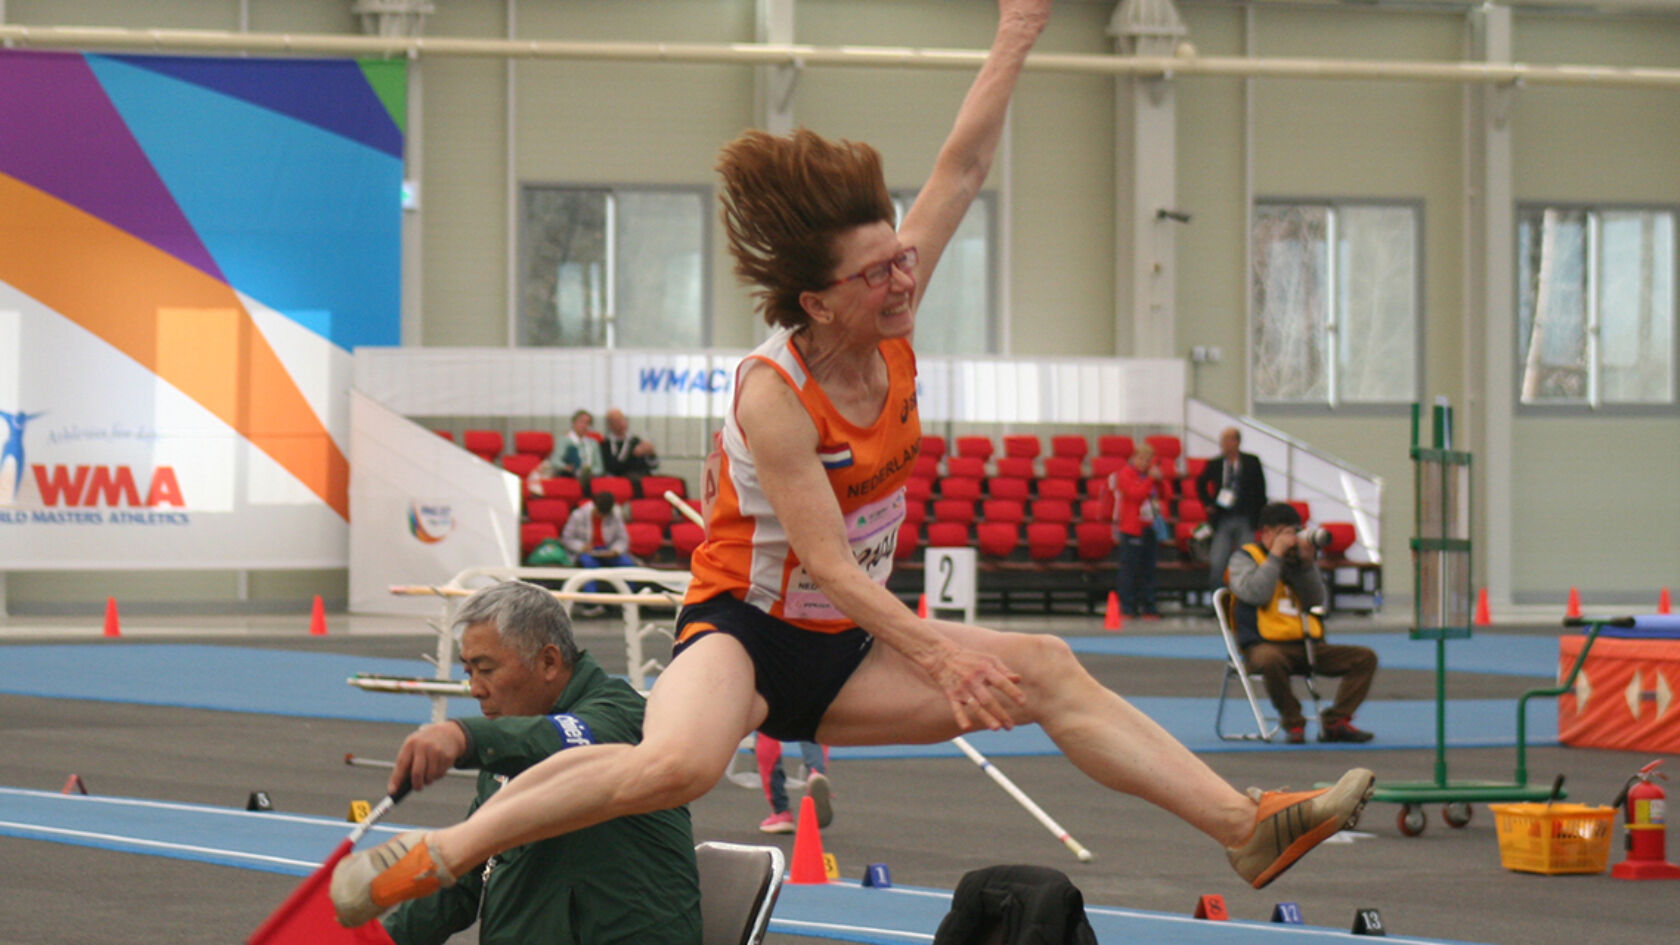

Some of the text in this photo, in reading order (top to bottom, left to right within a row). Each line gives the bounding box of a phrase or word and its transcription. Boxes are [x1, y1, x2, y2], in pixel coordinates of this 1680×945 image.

[847, 437, 922, 498] NEDERLAN
[31, 464, 186, 508] WMA
[32, 511, 103, 524] MASTERS
[109, 512, 190, 525] ATHLETICS
[940, 554, 953, 602] 2
[554, 714, 591, 745] Chief
[875, 866, 888, 884] 1
[1279, 904, 1300, 922] 17
[1361, 911, 1382, 930] 13
